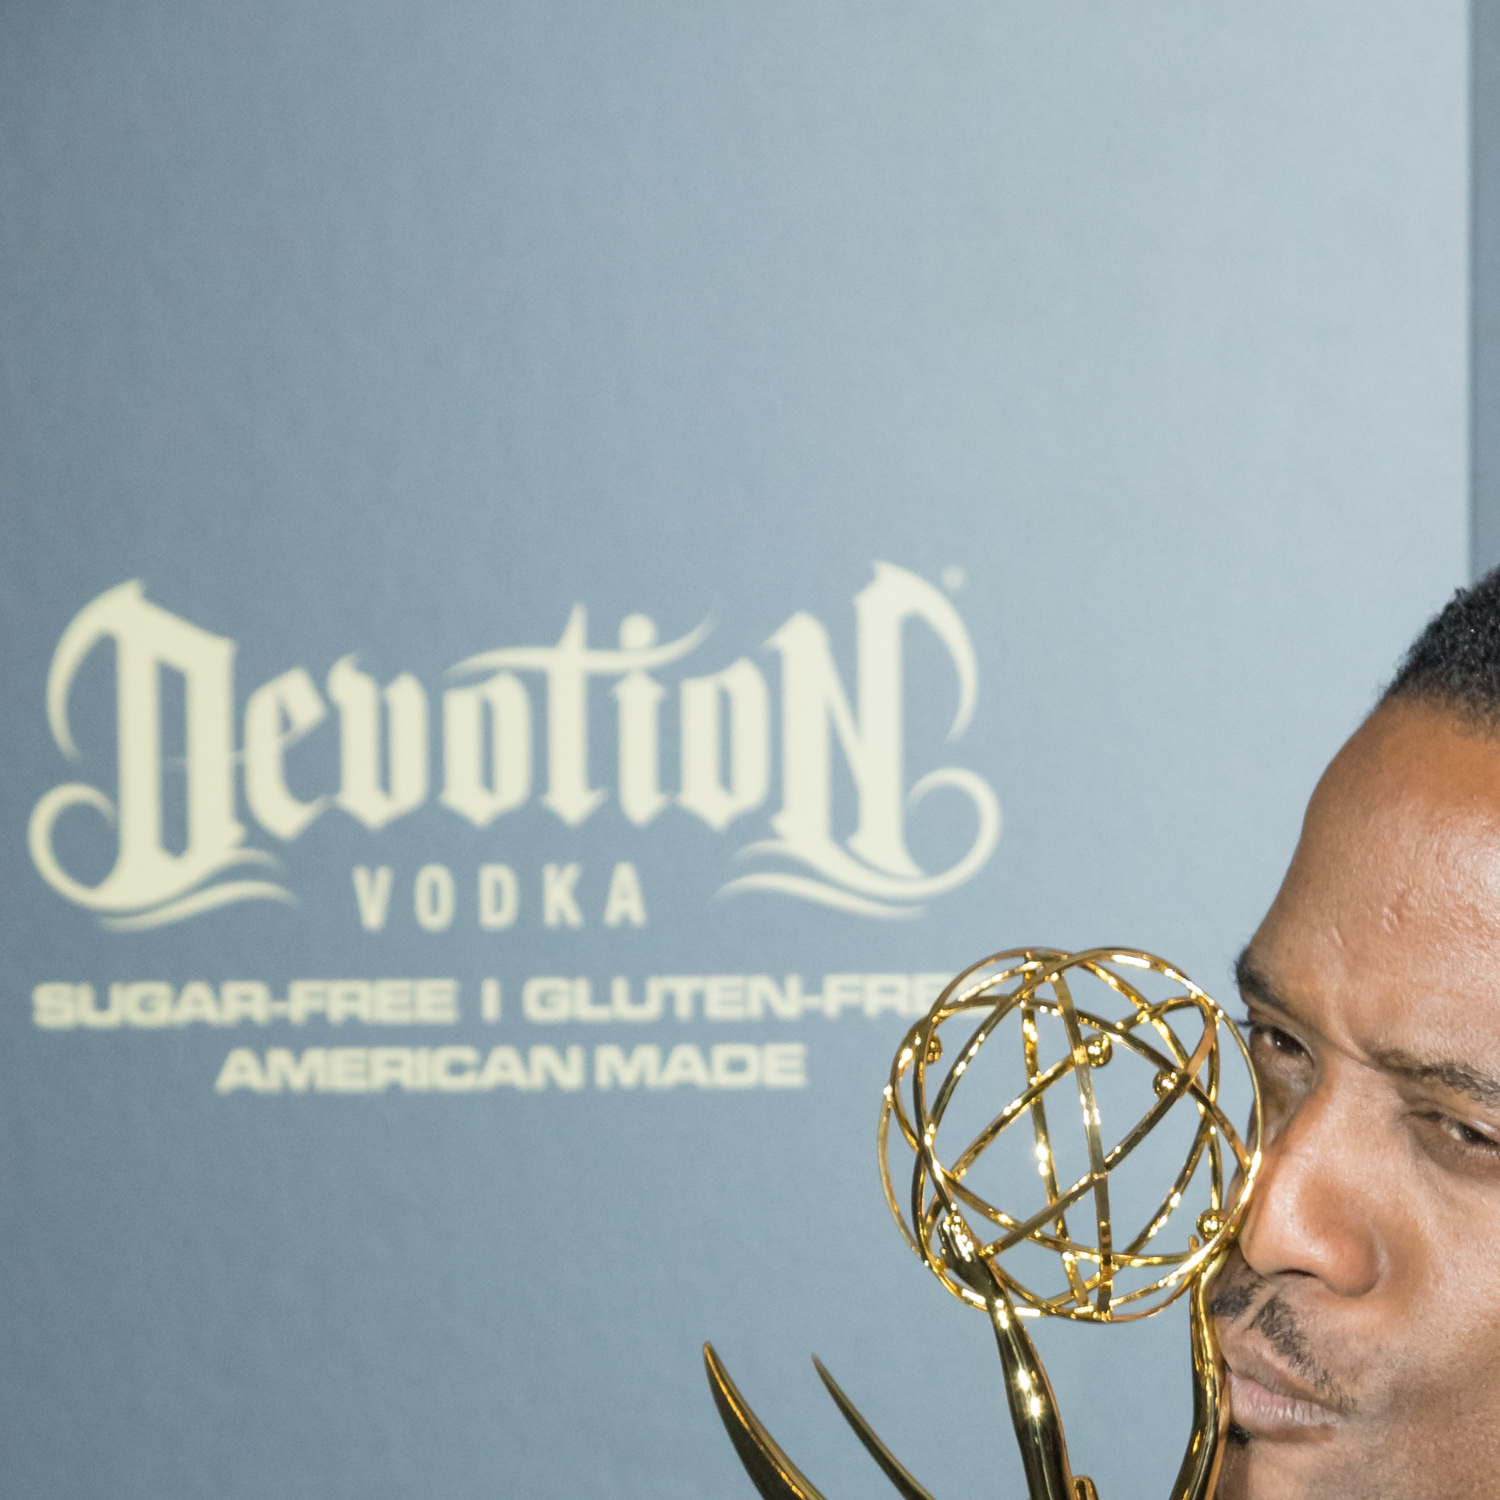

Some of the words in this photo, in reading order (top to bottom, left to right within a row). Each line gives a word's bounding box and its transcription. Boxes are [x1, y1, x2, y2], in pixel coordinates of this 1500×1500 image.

[352, 862, 646, 930] VODKA
[33, 980, 458, 1028] SUGAR-FREE
[214, 1046, 584, 1095] AMERICAN
[596, 1042, 806, 1090] MADE
